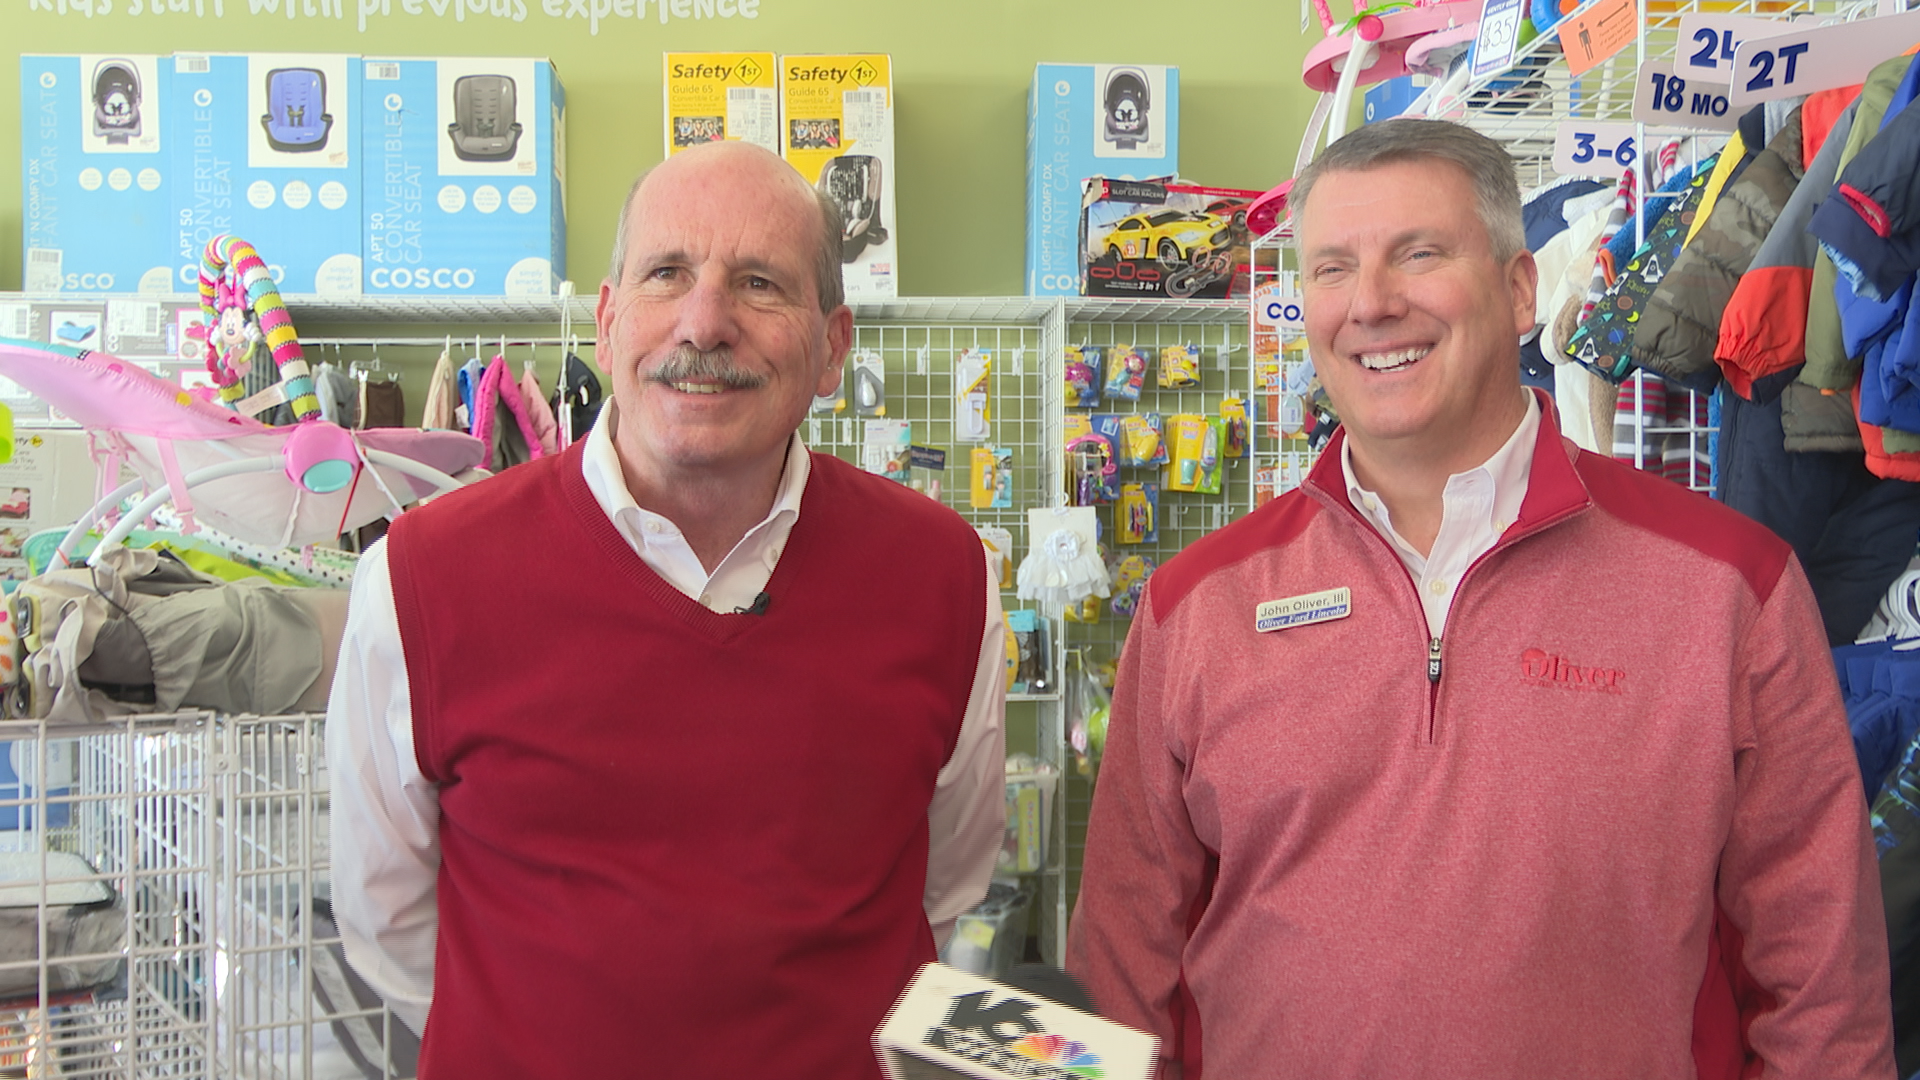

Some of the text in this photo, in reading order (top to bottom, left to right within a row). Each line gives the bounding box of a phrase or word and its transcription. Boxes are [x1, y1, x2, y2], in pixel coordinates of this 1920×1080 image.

[541, 0, 762, 36] experience
[1483, 16, 1512, 53] $35
[672, 64, 733, 81] Safety
[788, 67, 848, 84] Safety
[1746, 42, 1809, 92] 2T
[672, 84, 714, 94] Guide 65
[788, 87, 830, 97] Guide 65
[1651, 73, 1728, 117] 18 MO
[28, 158, 40, 175] DX
[1571, 132, 1637, 167] 3-6
[41, 89, 59, 249] FANT CAR SEAT
[213, 160, 231, 209] SEAT
[1042, 163, 1052, 180] DX
[1054, 96, 1070, 272] INFANT CAR SEAT
[28, 177, 40, 220] COMFY
[385, 114, 403, 264] CONVERTIBLE
[1042, 183, 1052, 222] COMFY
[1112, 188, 1165, 198] SLOT CAR RACERS
[405, 162, 422, 264] CAR SEAT
[180, 208, 193, 259] APT 50
[371, 213, 384, 263] APT 50
[1042, 241, 1052, 271] LIGHT
[58, 273, 115, 290] SCO
[370, 268, 475, 289] COSCO
[1267, 303, 1304, 321] CO
[1259, 606, 1346, 629] Oliver Ford Lincoln
[1261, 593, 1344, 617] John Oliver, III
[1521, 649, 1626, 687] Oliver
[948, 990, 1042, 1049] 16
